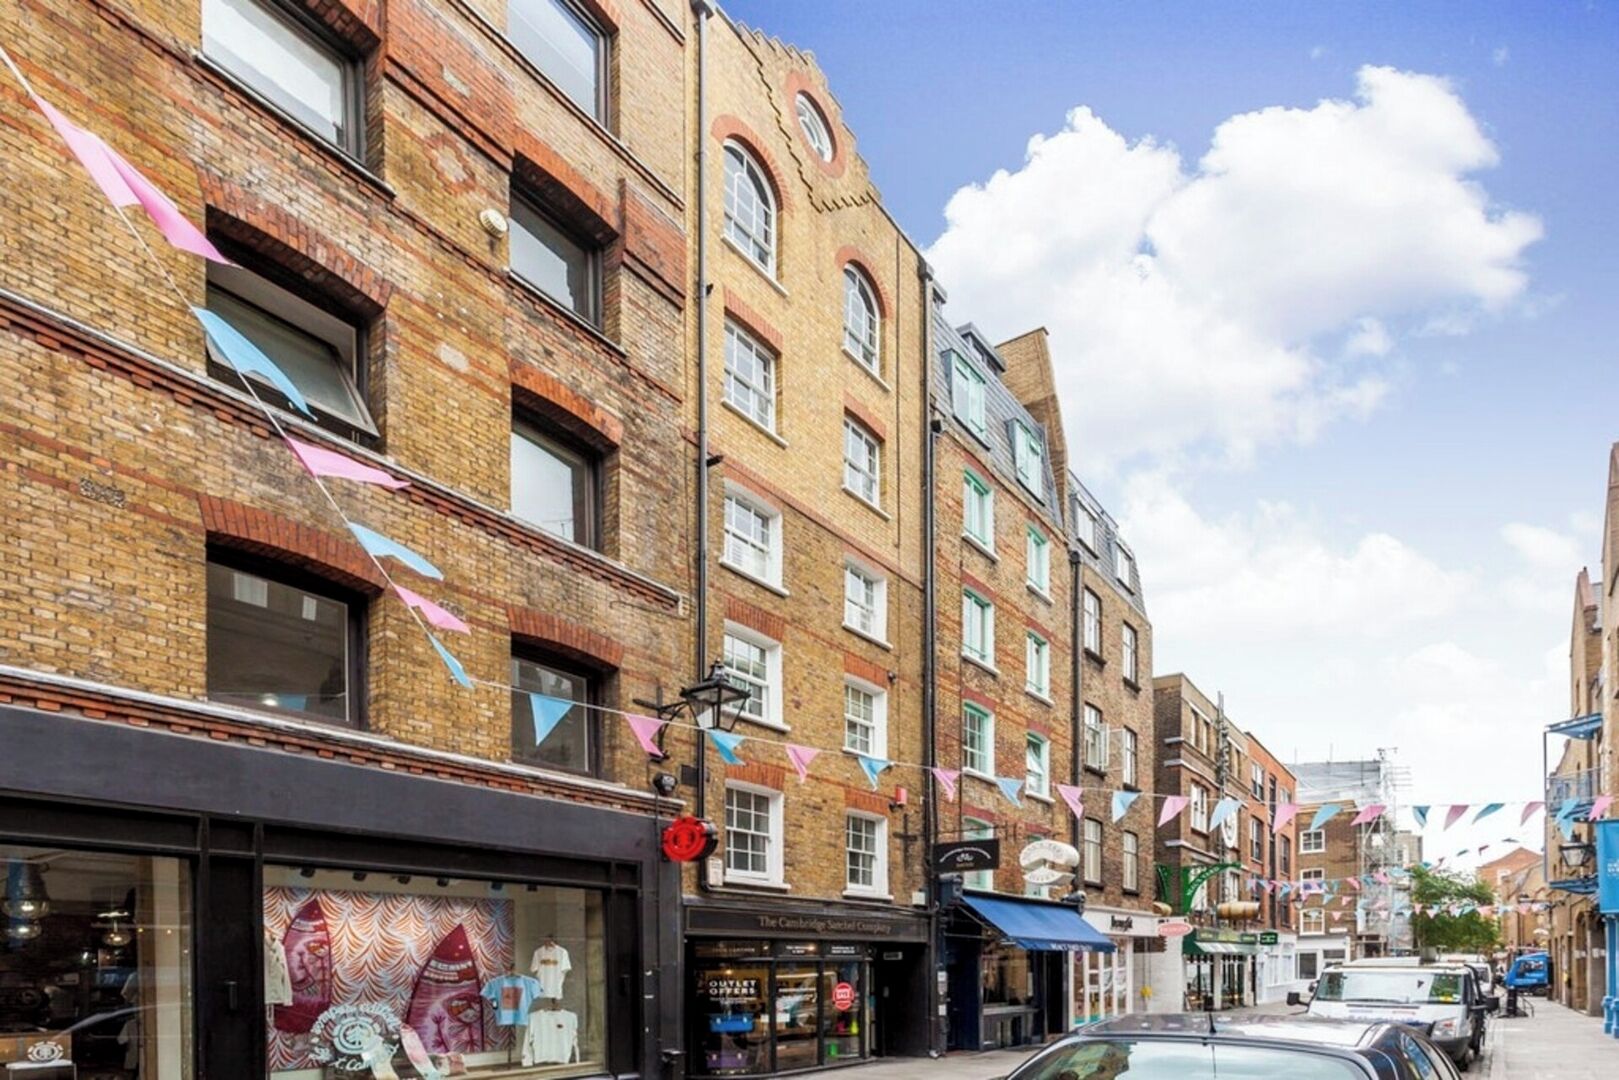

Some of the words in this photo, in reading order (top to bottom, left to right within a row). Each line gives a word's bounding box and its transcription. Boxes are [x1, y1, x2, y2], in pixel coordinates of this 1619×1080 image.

[759, 915, 777, 928] The
[779, 916, 827, 934] Cambridge
[709, 980, 757, 988] OUTLET
[709, 987, 756, 995] OFFERS
